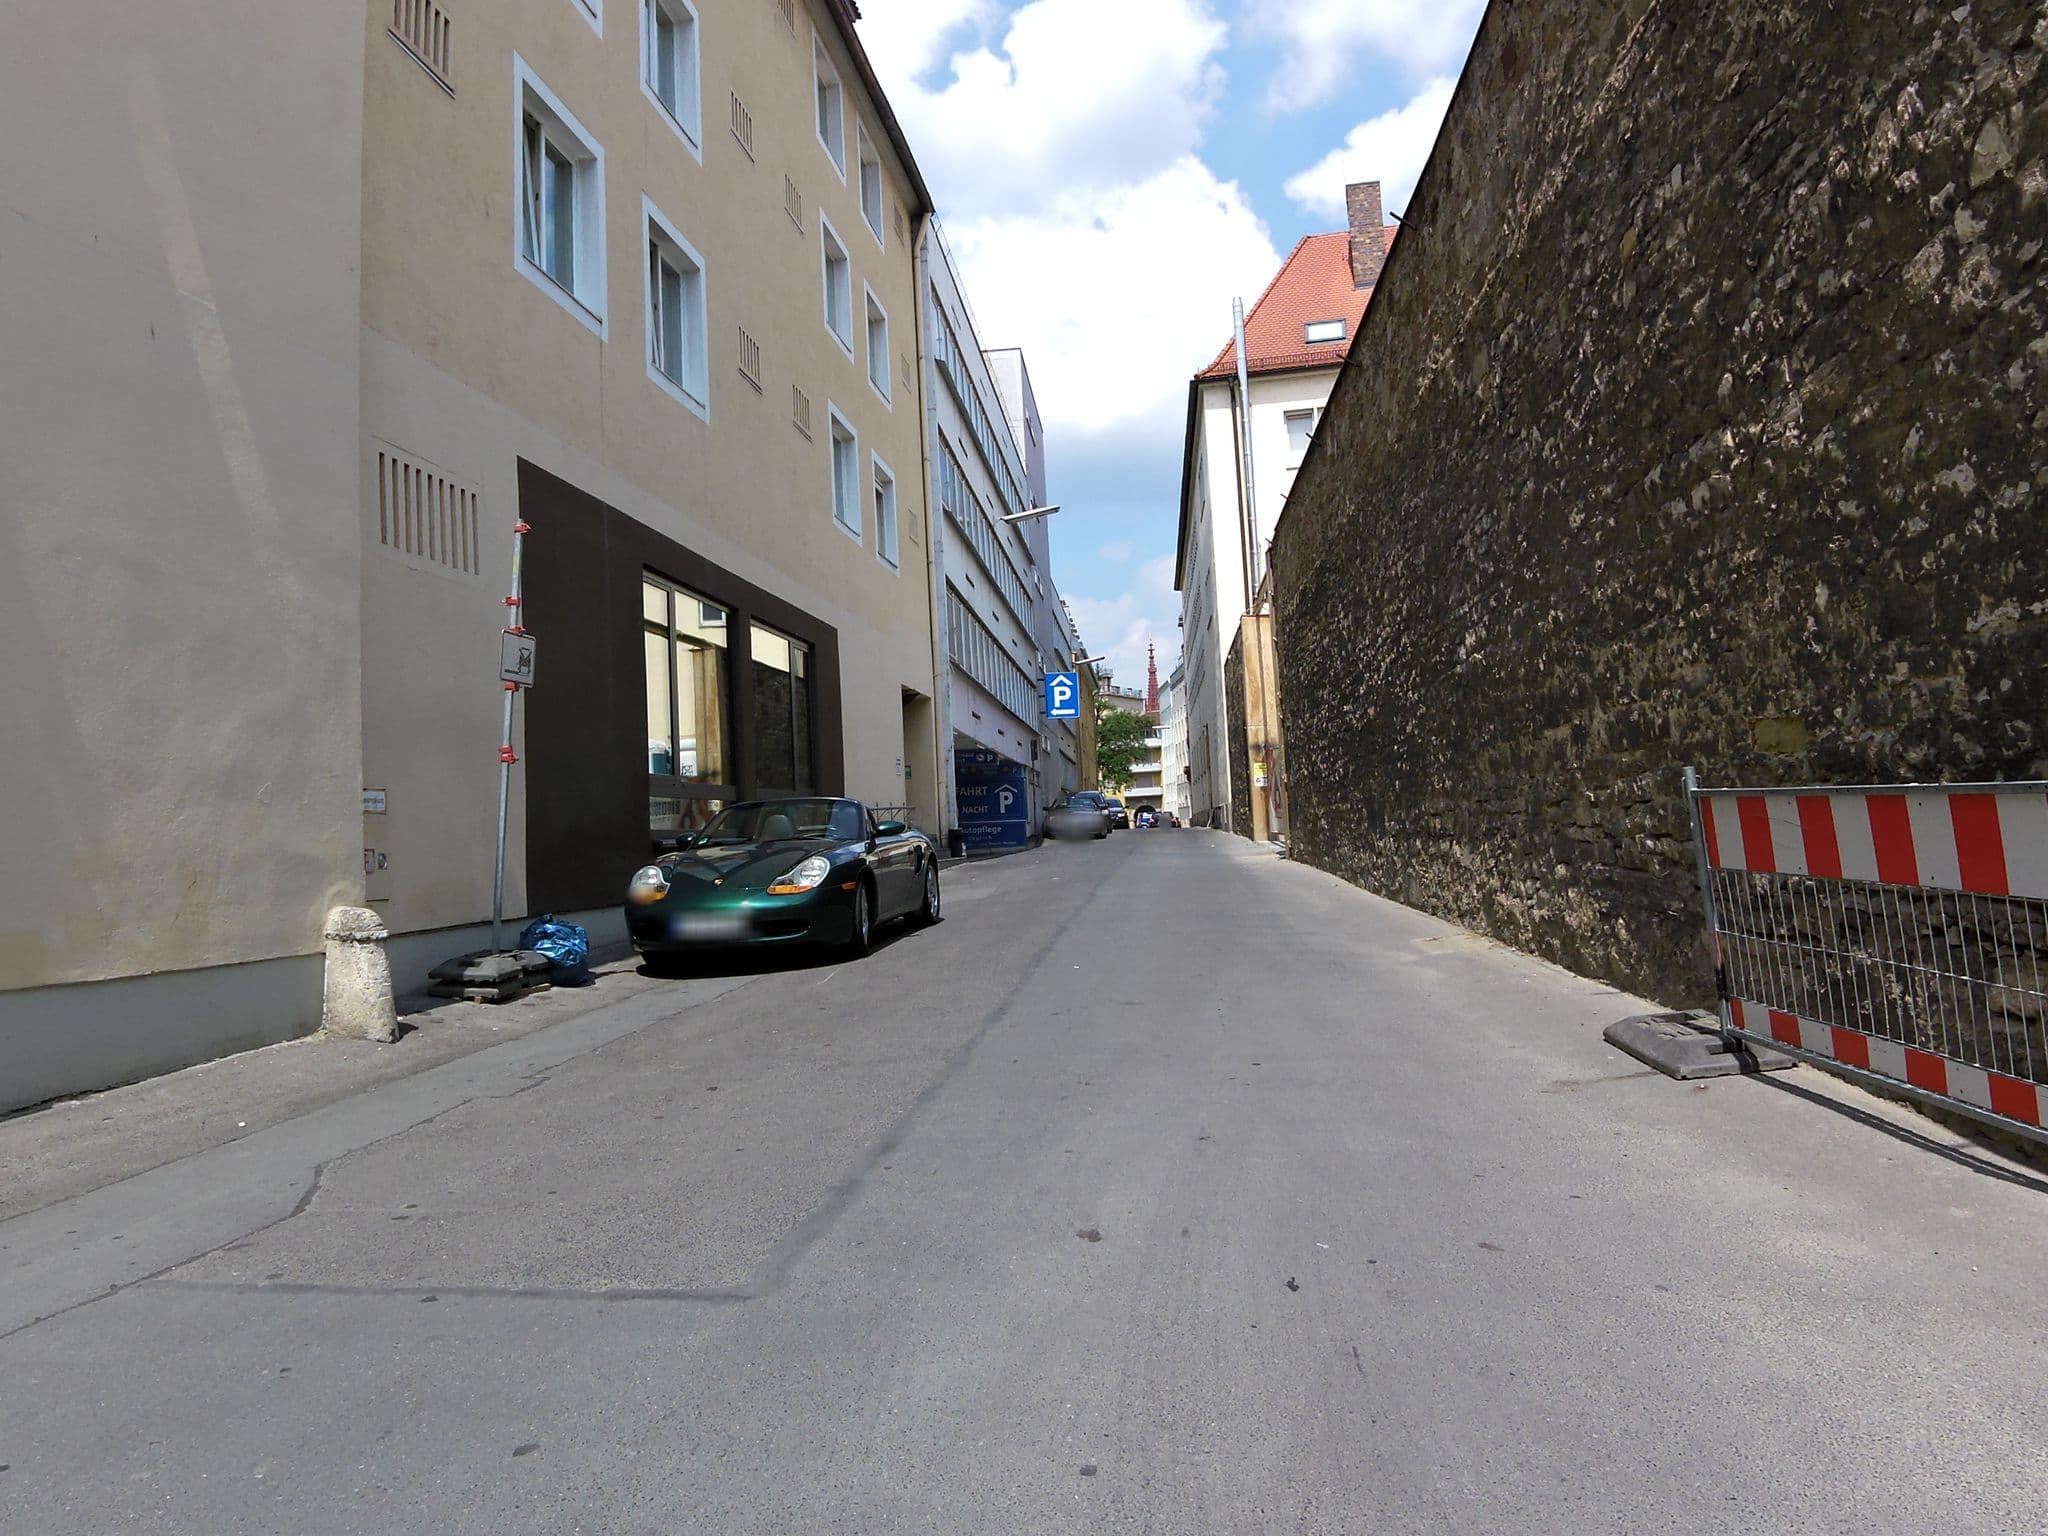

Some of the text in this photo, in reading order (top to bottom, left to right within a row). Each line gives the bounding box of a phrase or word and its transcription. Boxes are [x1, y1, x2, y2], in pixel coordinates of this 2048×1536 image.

[1054, 686, 1072, 708] P
[962, 805, 989, 814] NACHT
[1000, 791, 1014, 814] P
